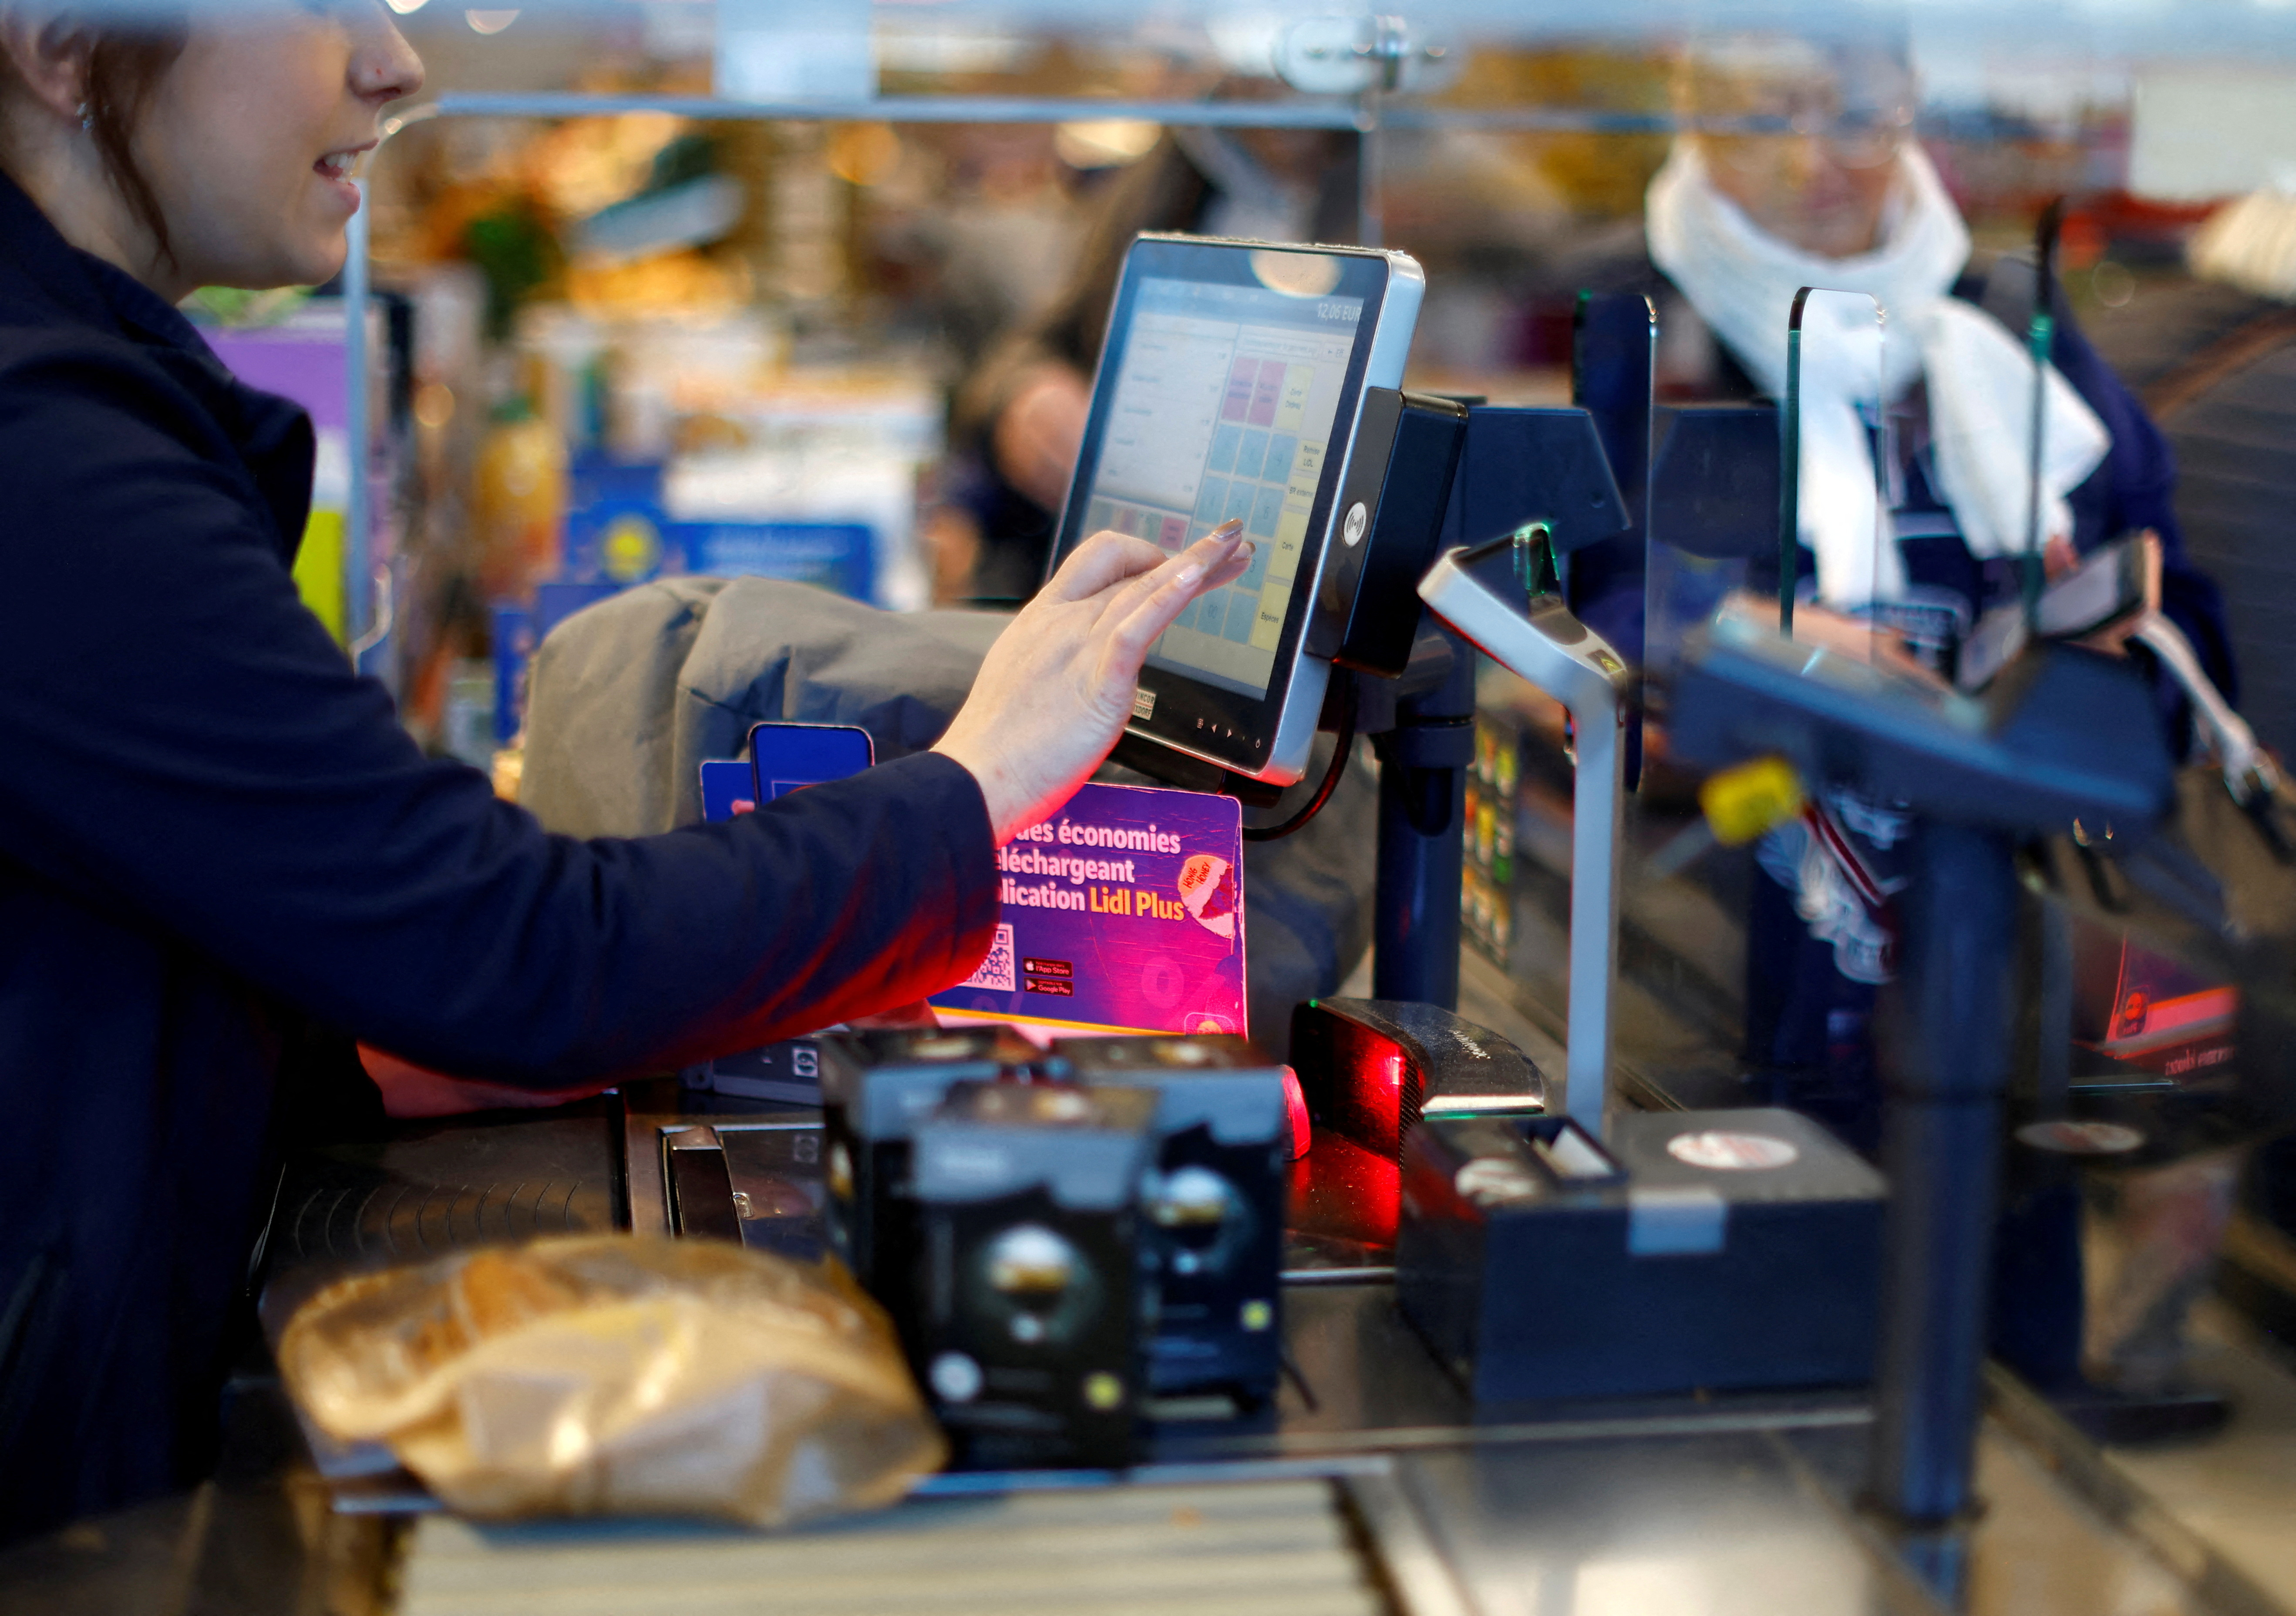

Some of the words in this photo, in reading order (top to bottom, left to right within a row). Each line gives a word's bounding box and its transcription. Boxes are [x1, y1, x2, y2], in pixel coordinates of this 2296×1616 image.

[1318, 303, 1341, 321] 12,06
[1342, 306, 1362, 322] EUR
[1282, 541, 1294, 551] Carte
[1136, 692, 1155, 705] INCOR
[1135, 705, 1151, 717] XDORF
[1058, 819, 1181, 854] économies
[1182, 867, 1198, 889] HONIG
[1196, 862, 1211, 884] HONEY
[996, 878, 1085, 911] lication
[1091, 886, 1131, 915] Lidl
[1136, 891, 1185, 921] Plus
[1053, 967, 1069, 975] Store
[1038, 984, 1058, 994] Google
[1059, 986, 1071, 995] Play
